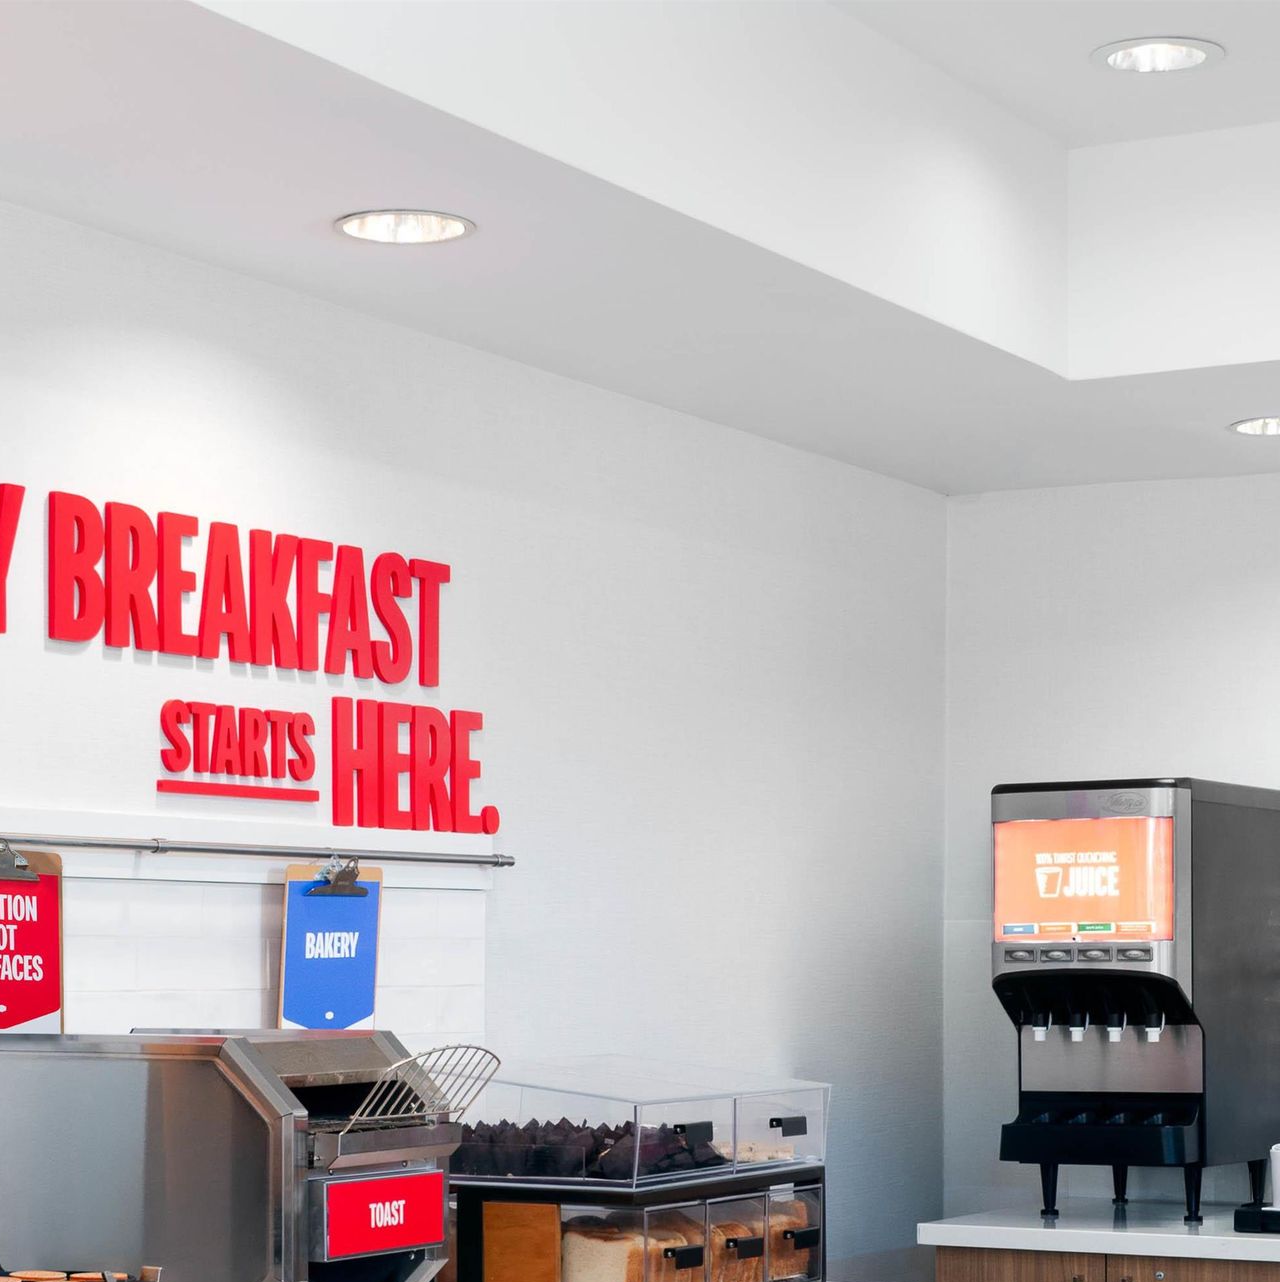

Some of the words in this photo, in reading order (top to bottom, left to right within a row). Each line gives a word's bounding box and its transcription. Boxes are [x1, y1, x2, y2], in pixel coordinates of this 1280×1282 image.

[49, 491, 451, 688] BREAKFAST
[160, 699, 316, 781] STARTS
[332, 696, 500, 834] HERE.
[1063, 866, 1120, 896] JUICE
[305, 931, 359, 959] BAKERY
[369, 1199, 406, 1229] TOAST
